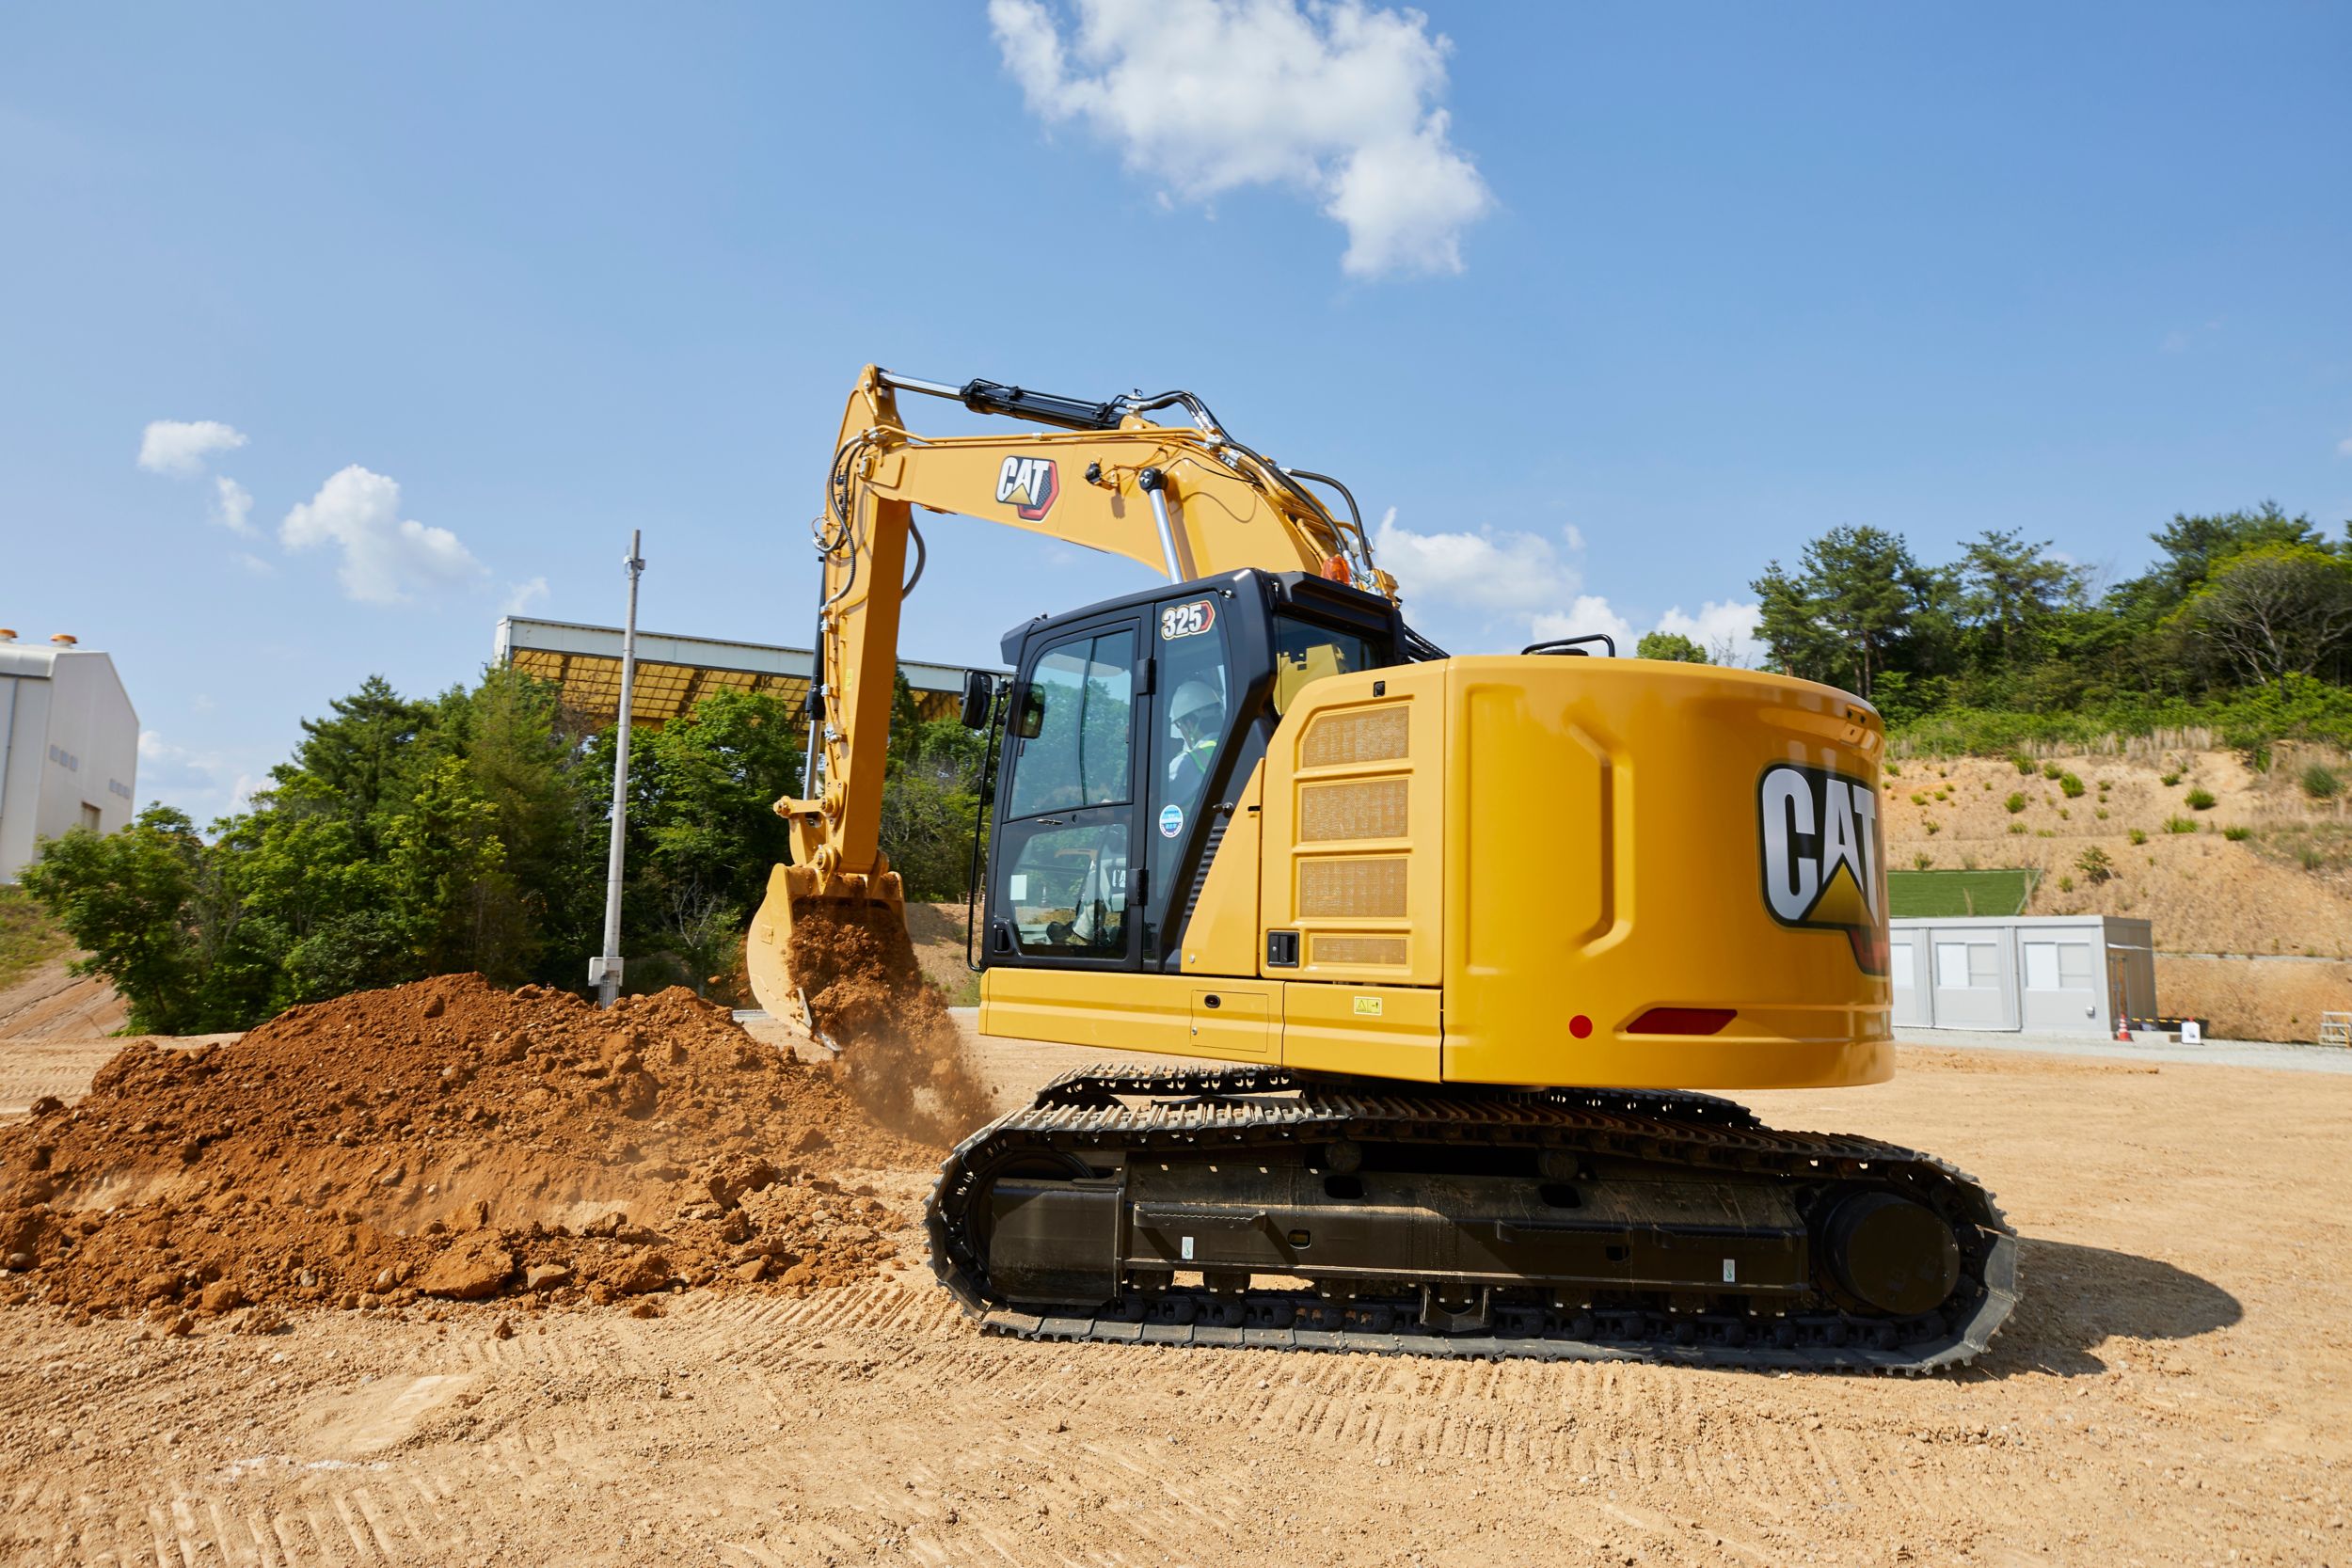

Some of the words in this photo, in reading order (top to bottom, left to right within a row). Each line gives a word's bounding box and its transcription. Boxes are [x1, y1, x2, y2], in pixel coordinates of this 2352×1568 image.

[996, 456, 1051, 506] CAT
[1163, 604, 1202, 638] 325
[1762, 768, 1880, 927] CAT
